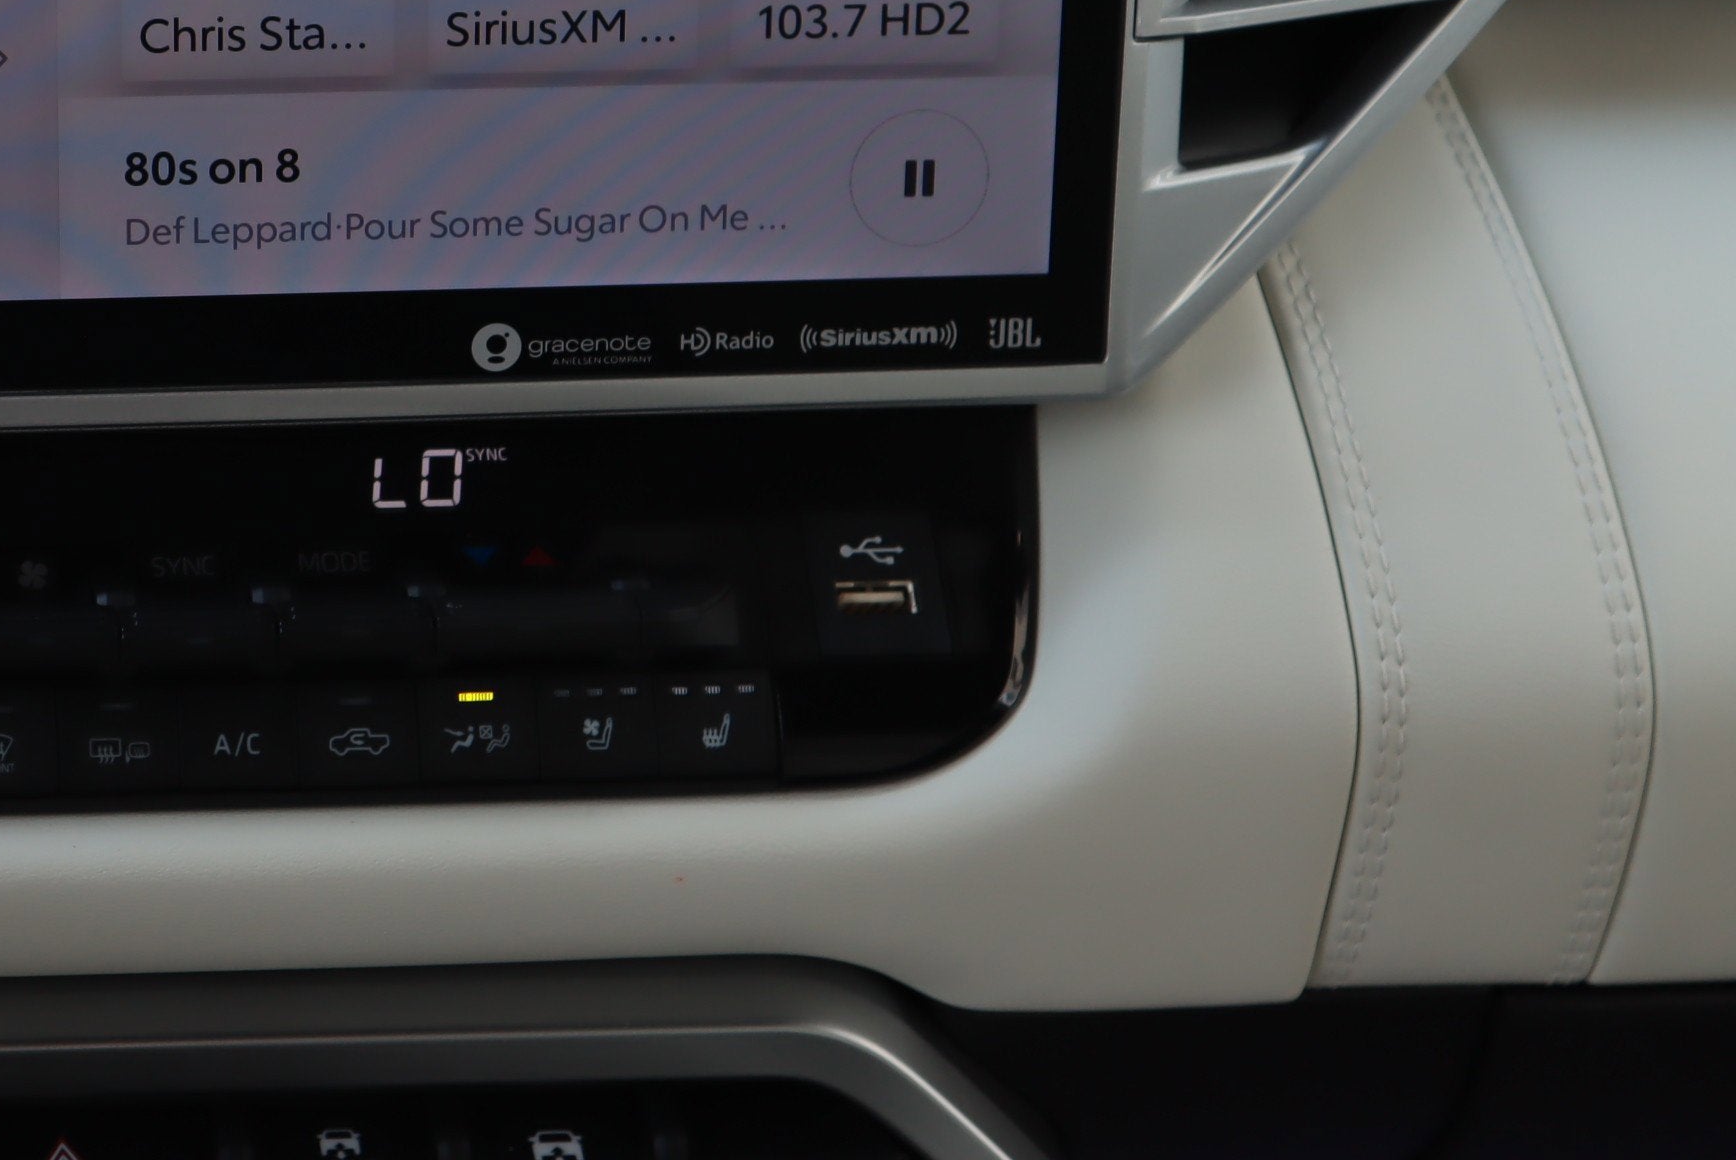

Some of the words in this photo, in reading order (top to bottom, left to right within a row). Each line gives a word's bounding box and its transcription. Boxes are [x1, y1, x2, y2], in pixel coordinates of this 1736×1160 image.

[446, 9, 626, 48] SiriusXM
[758, 3, 867, 40] 103.7
[880, 0, 970, 37] HD2
[139, 16, 246, 54] Chris
[124, 151, 198, 187] 80s
[208, 157, 263, 185] on
[275, 148, 301, 184] 8
[126, 215, 186, 246] Def
[429, 209, 524, 239] Some
[534, 207, 632, 243] Sugar
[638, 204, 689, 234] On
[699, 203, 749, 231] Me
[527, 335, 652, 358] gracenote
[715, 330, 775, 350] Radio
[989, 317, 1042, 349] JBL
[465, 447, 508, 463] SYNC
[151, 554, 215, 578] SYNC
[298, 550, 372, 574] MODE
[213, 732, 261, 757] A/C
